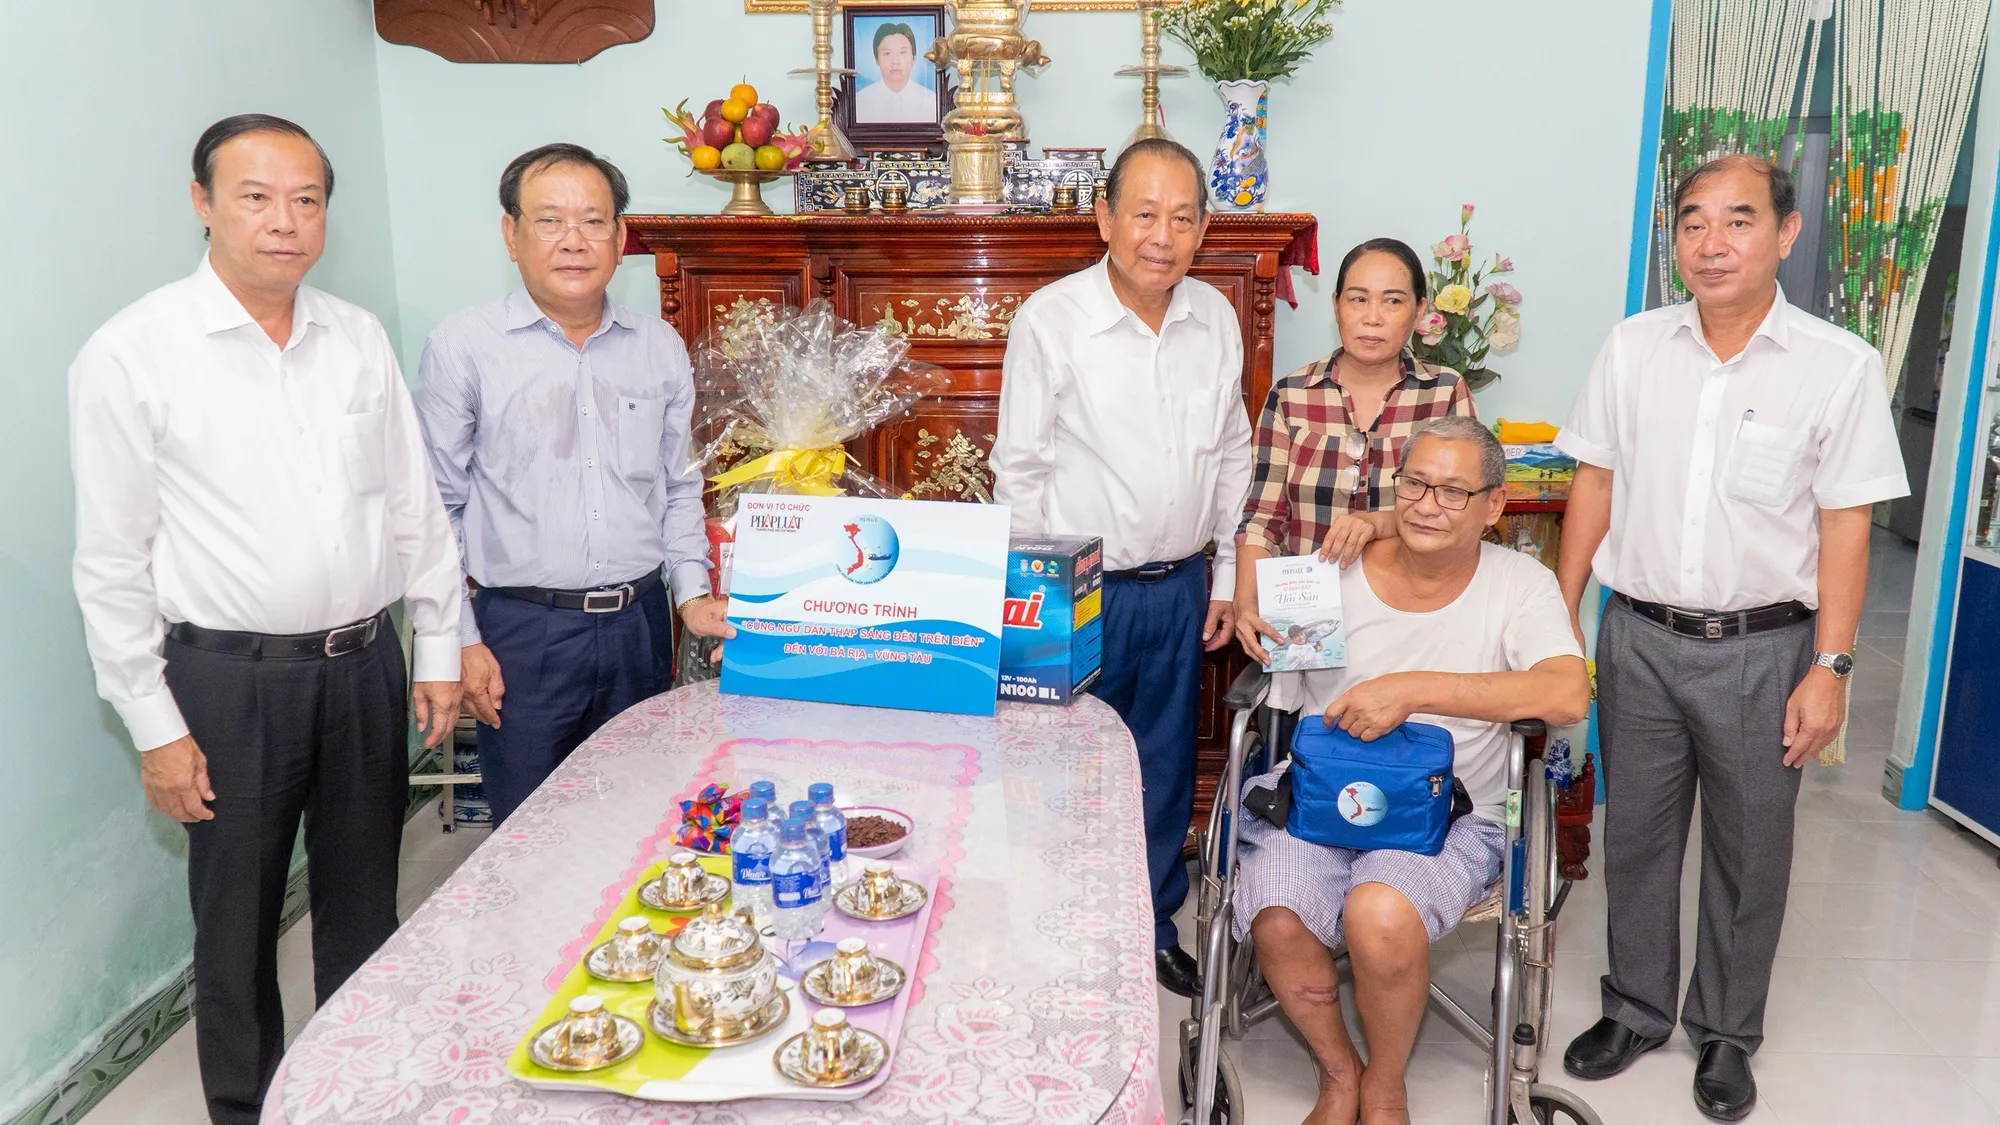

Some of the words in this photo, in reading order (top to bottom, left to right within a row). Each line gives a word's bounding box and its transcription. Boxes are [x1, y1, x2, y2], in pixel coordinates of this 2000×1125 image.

[747, 502, 764, 510] ĐƠN
[766, 503, 774, 512] VỊ
[787, 503, 811, 511] CHỨC
[803, 599, 868, 616] CHƯƠNG
[873, 602, 918, 618] TRÌNH
[1002, 592, 1043, 630] ai
[804, 624, 826, 635] DÂN
[859, 627, 891, 640] SÁNG
[893, 629, 916, 642] ĐÈN
[919, 632, 949, 645] TRÊN
[808, 643, 828, 655] VỚI
[830, 645, 845, 657] BÀ
[848, 648, 866, 661] RỊA
[875, 649, 906, 662] VŨNG
[909, 652, 932, 664] TÀU
[1016, 676, 1037, 684] 100Ah
[1000, 683, 1037, 697] N100
[1050, 687, 1060, 700] L
